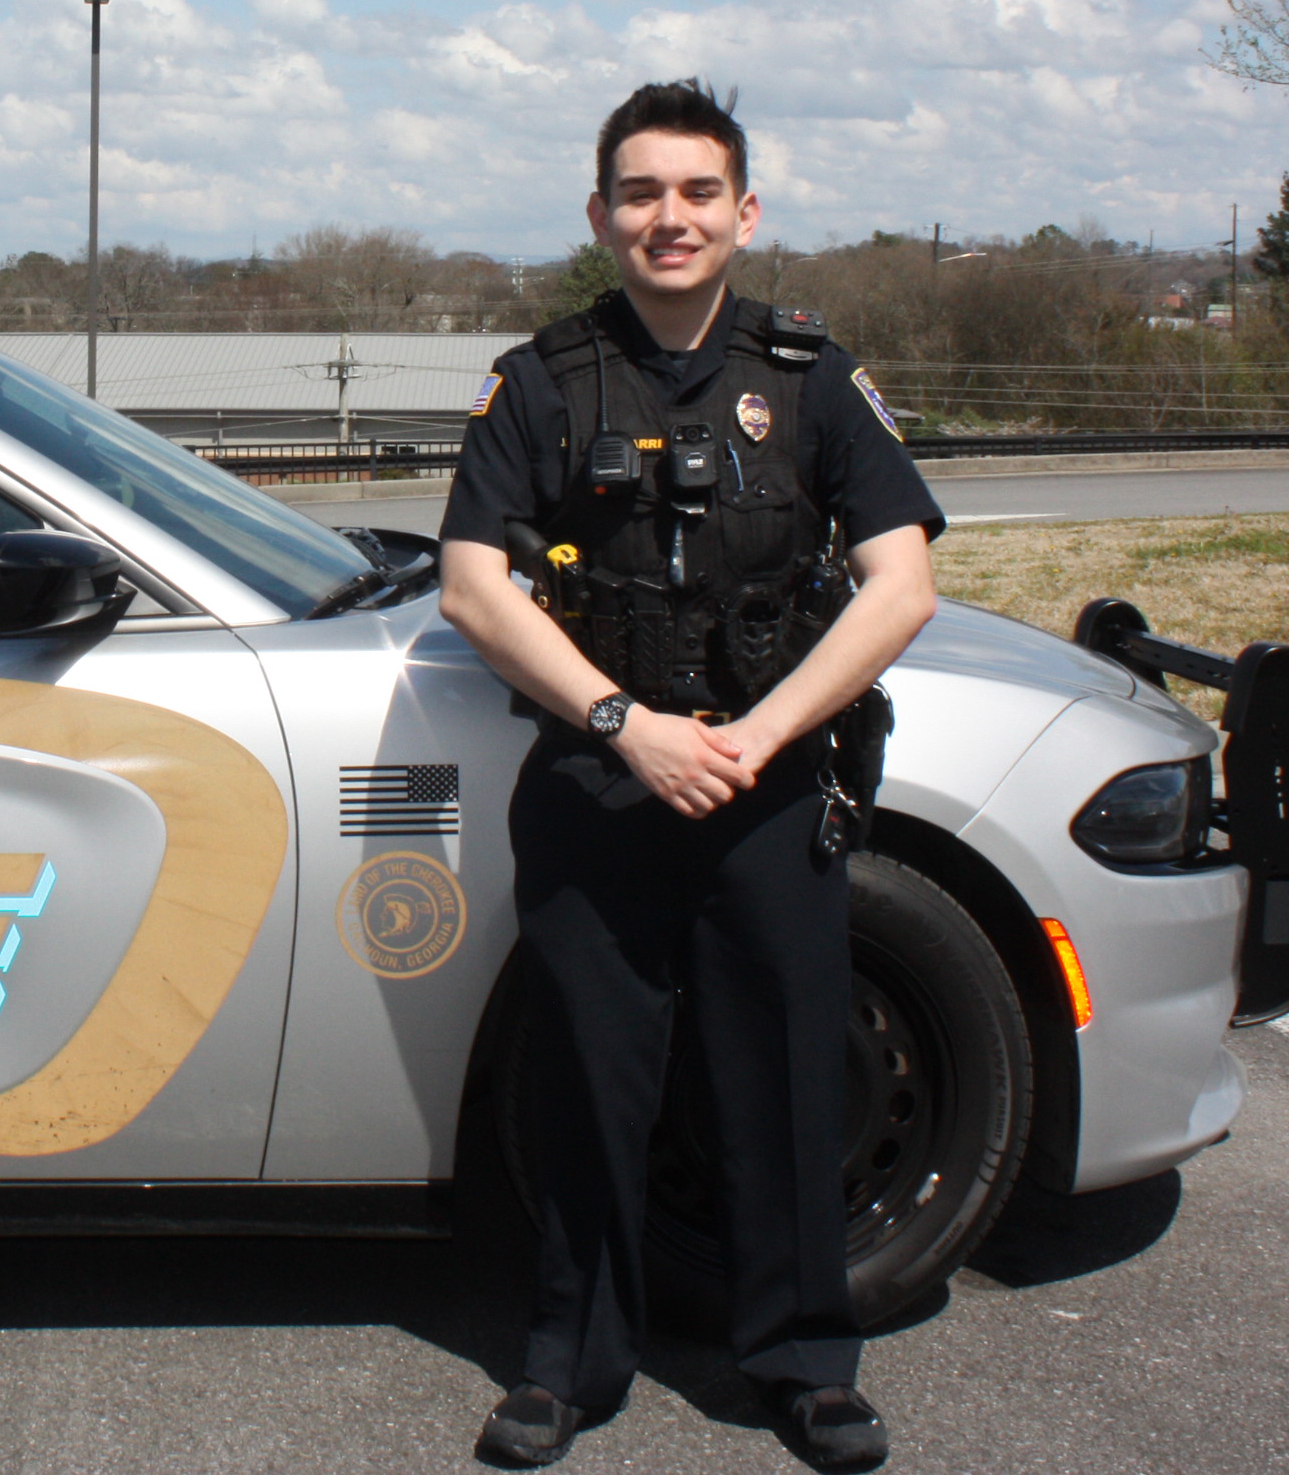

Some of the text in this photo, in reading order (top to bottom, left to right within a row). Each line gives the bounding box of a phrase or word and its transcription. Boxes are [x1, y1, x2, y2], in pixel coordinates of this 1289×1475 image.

[347, 862, 455, 915] LAND OF THE CHEROKEE
[406, 923, 453, 968] GEORGIA
